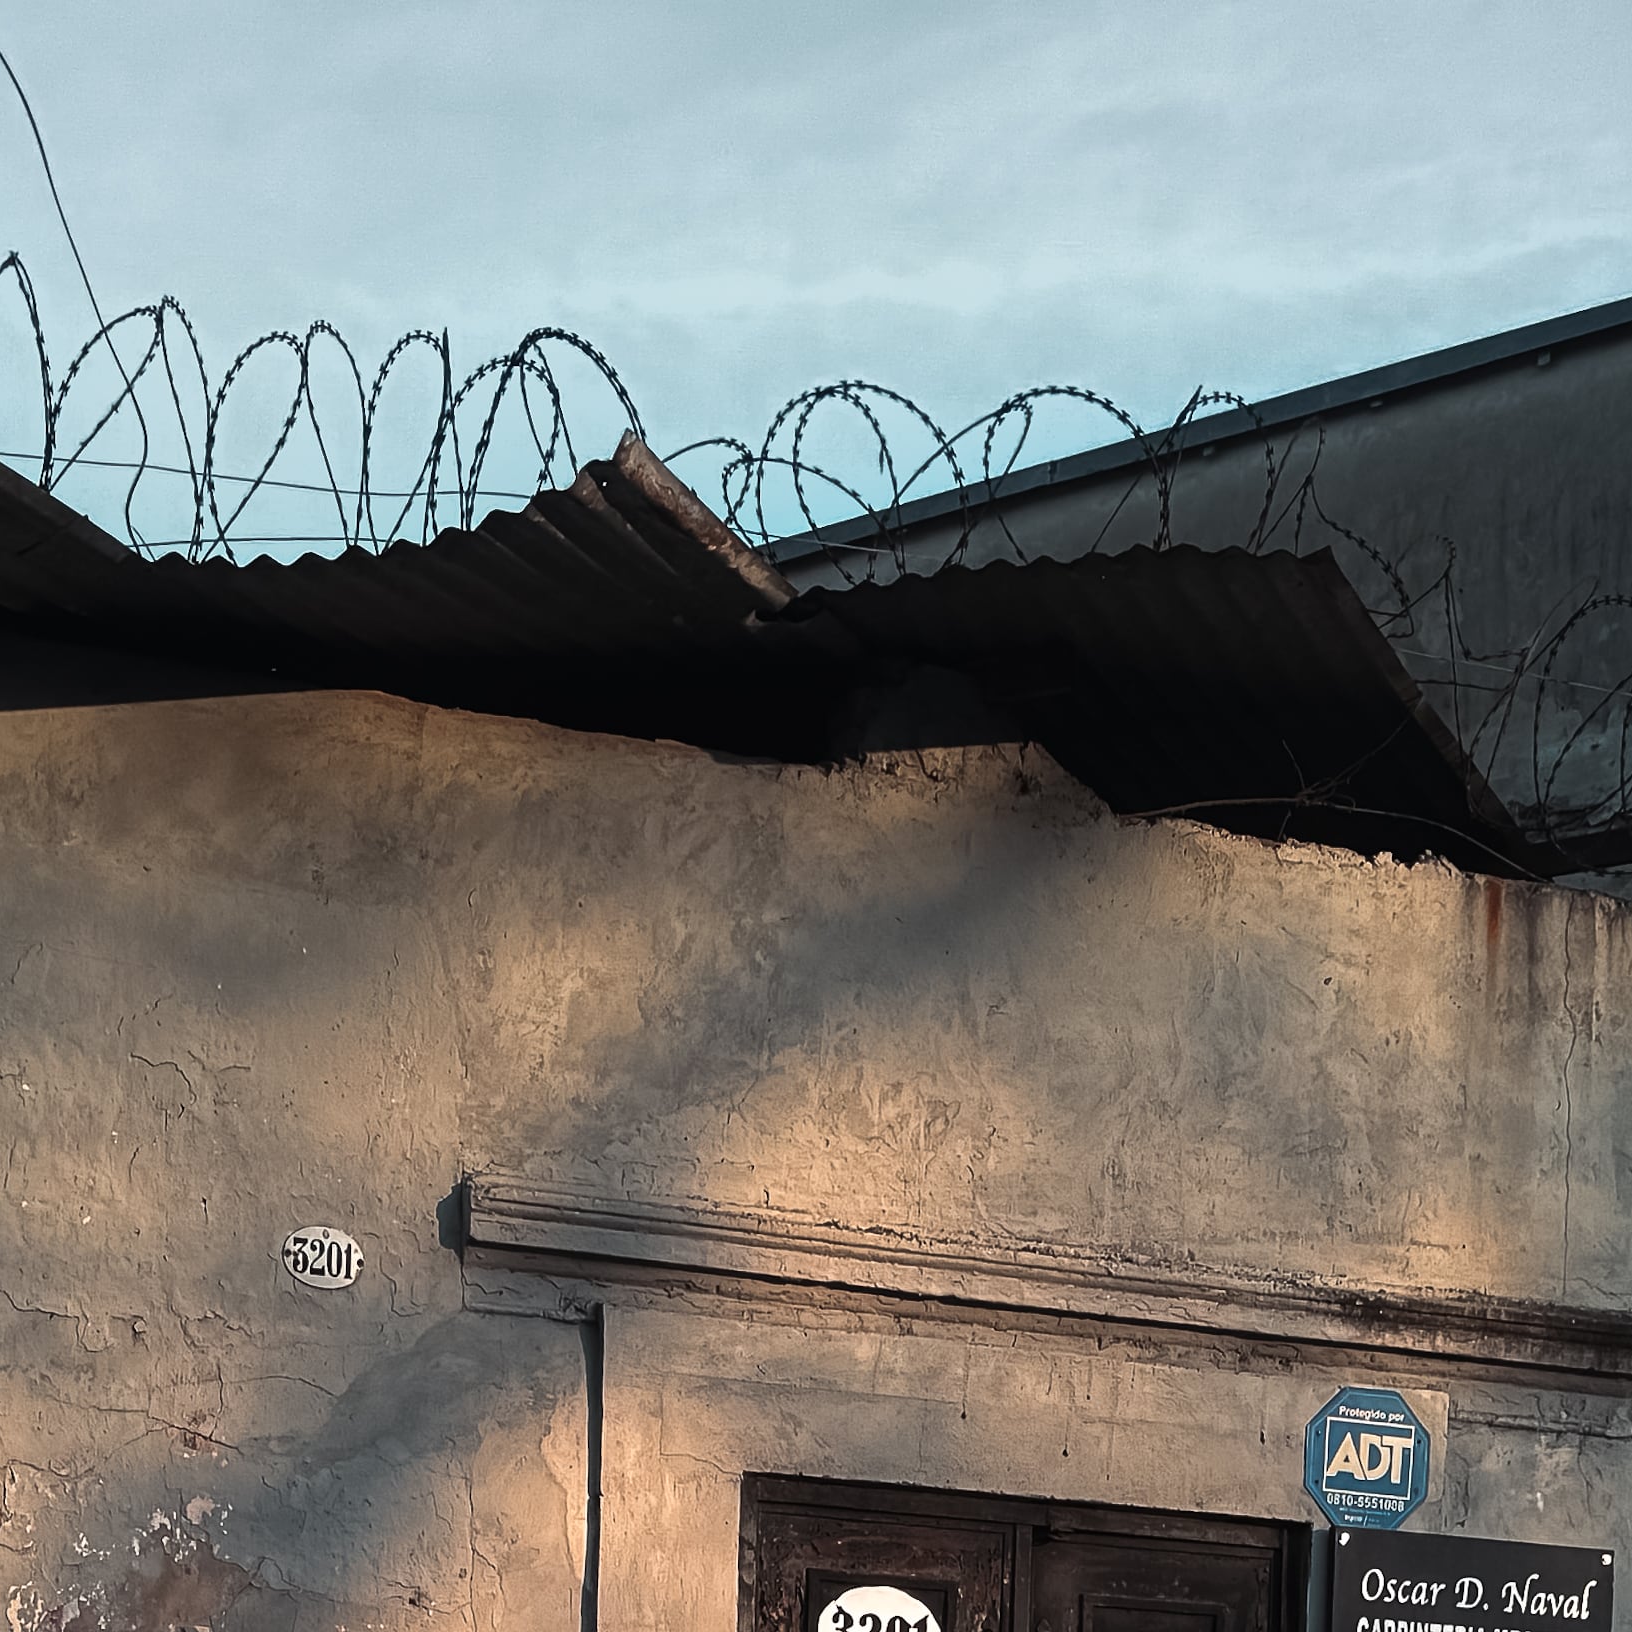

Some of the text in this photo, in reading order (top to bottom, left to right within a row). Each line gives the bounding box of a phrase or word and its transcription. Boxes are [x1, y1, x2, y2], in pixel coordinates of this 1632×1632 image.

[292, 1236, 353, 1280] 3201
[1338, 1405, 1405, 1422] Protegido por
[1326, 1431, 1414, 1484] ADT
[1361, 1568, 1597, 1620] Oscar D. Naval
